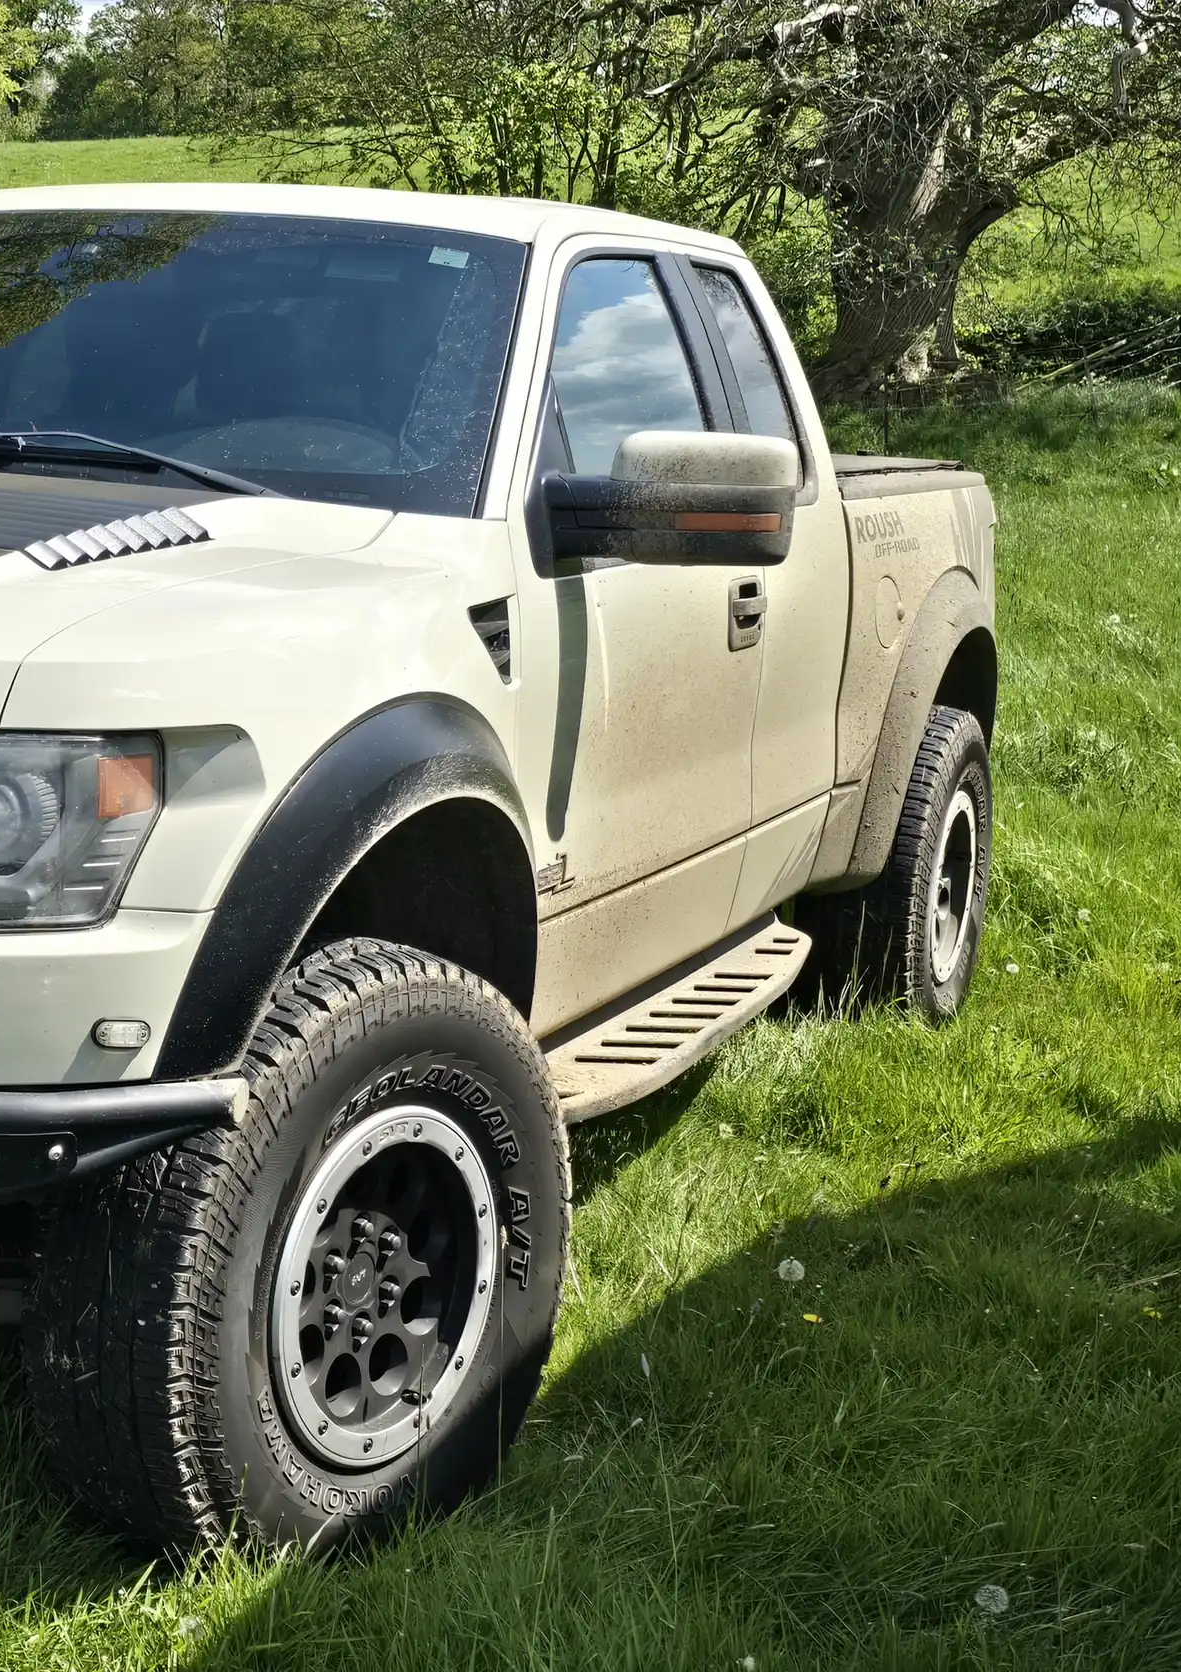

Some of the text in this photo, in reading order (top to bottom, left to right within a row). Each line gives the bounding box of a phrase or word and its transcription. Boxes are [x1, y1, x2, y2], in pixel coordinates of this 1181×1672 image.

[854, 510, 905, 544] ROUSH
[875, 537, 920, 558] OFF-ROAD
[324, 1064, 521, 1168] GEOLANDAR
[507, 1186, 532, 1290] A/T
